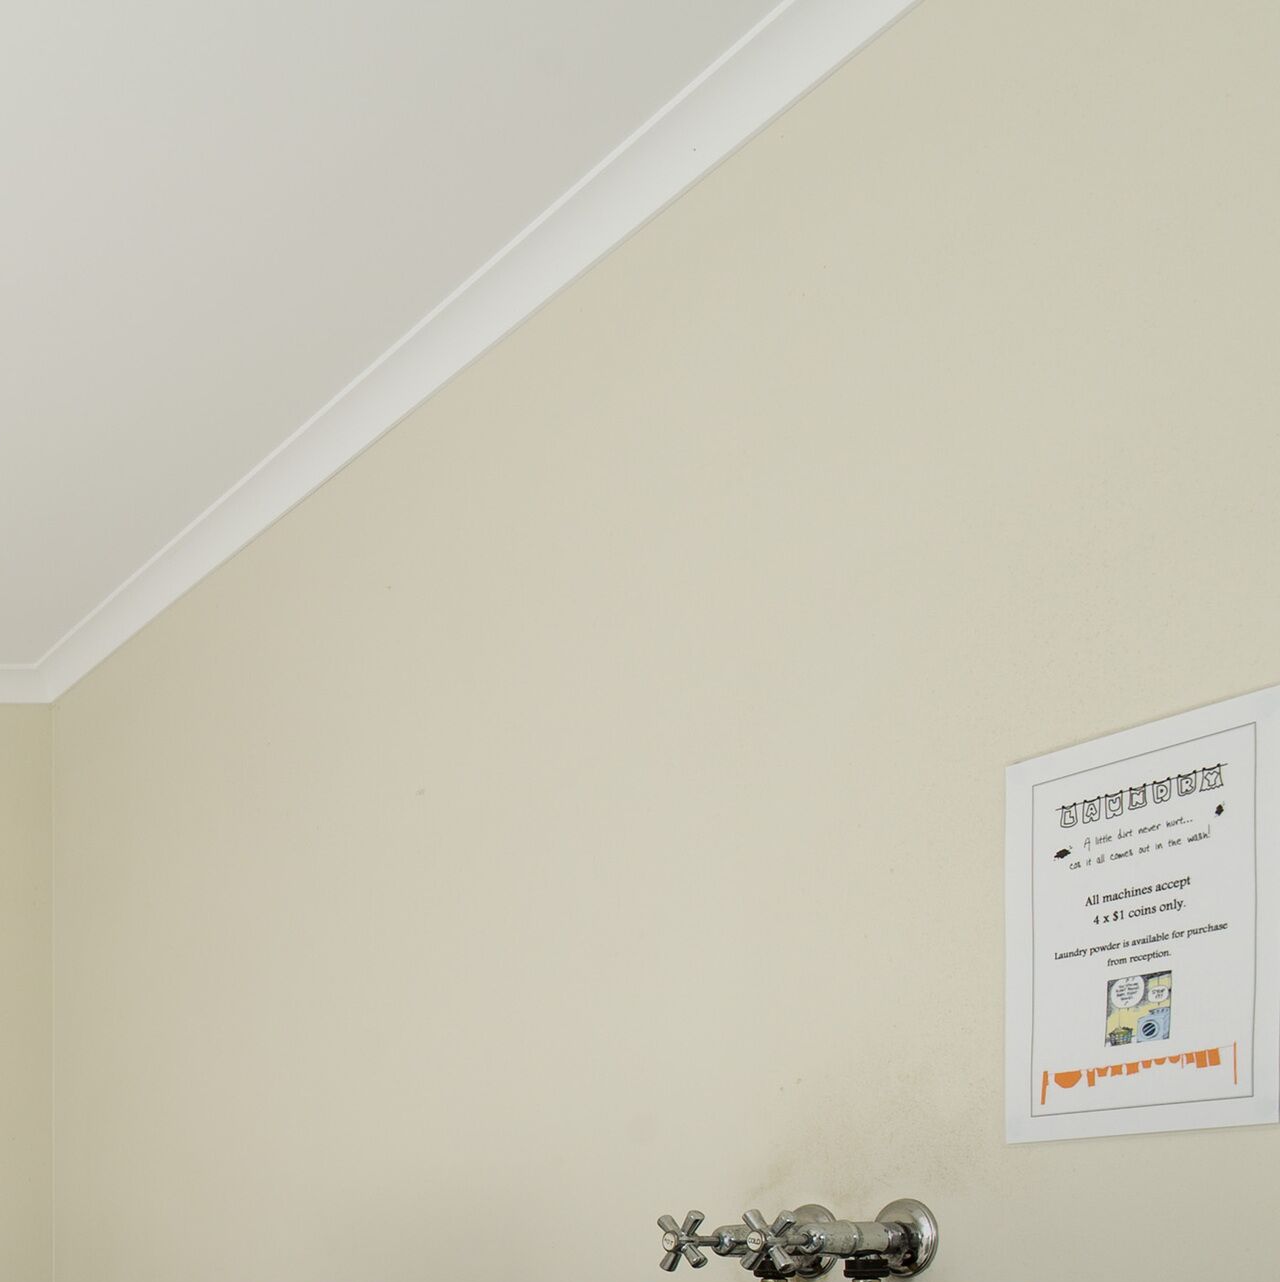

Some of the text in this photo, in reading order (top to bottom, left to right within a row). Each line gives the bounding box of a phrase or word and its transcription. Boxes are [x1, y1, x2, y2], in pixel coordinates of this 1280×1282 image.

[1060, 766, 1223, 827] LAUNDRY
[1084, 837, 1091, 851] A
[1095, 834, 1112, 845] little
[1118, 829, 1132, 839] dirt
[1138, 823, 1161, 834] never
[1086, 858, 1091, 866] it
[1110, 850, 1133, 860] comes
[1139, 845, 1149, 854] out
[1156, 842, 1162, 850] in
[1168, 838, 1182, 847] the
[1188, 824, 1210, 842] wash!
[1085, 876, 1191, 907] All machines accept
[1093, 898, 1186, 925] 4 x $1 coins only.
[1054, 922, 1228, 960] Laundry powder is available for purchase
[1107, 950, 1171, 967] from reception.
